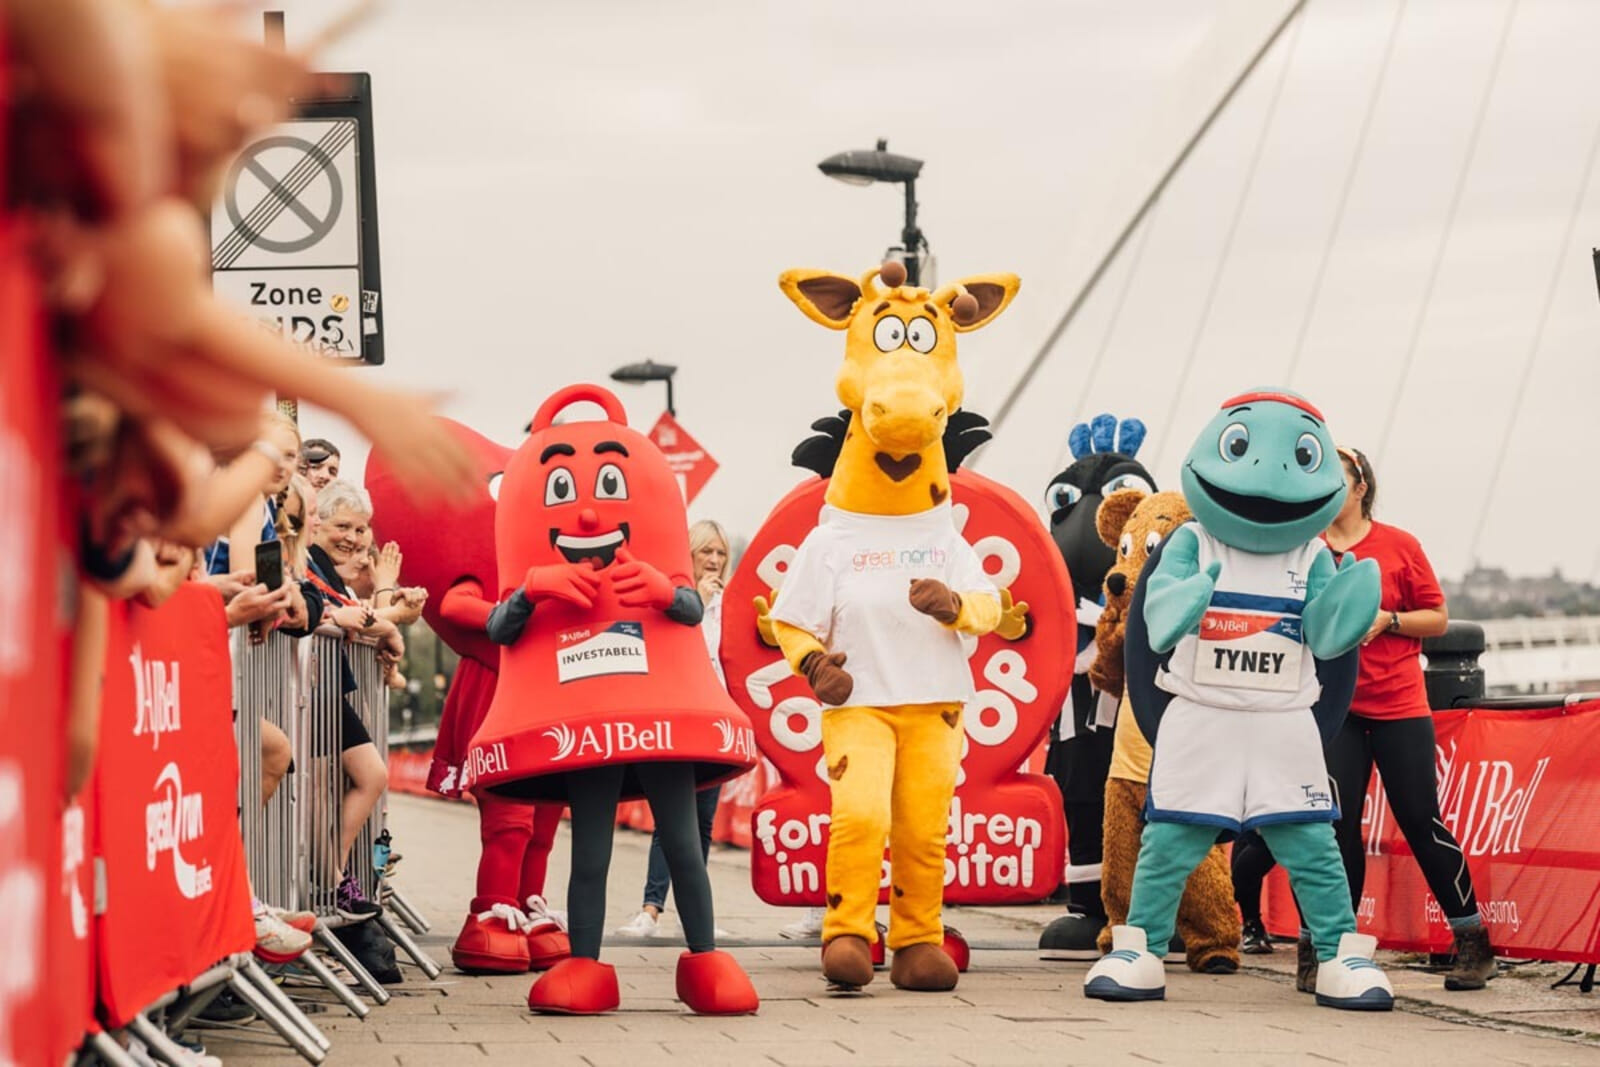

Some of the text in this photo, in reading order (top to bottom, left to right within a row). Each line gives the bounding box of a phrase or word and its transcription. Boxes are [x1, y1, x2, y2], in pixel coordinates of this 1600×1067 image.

[250, 282, 322, 305] Zone
[900, 546, 946, 565] north
[1216, 620, 1248, 633] AJBell
[562, 646, 642, 665] INVESTABELL
[1214, 647, 1285, 674] TYNEY
[577, 720, 673, 760] AJBell
[1443, 757, 1550, 856] AJBell
[757, 809, 831, 855] for
[776, 851, 819, 894] in
